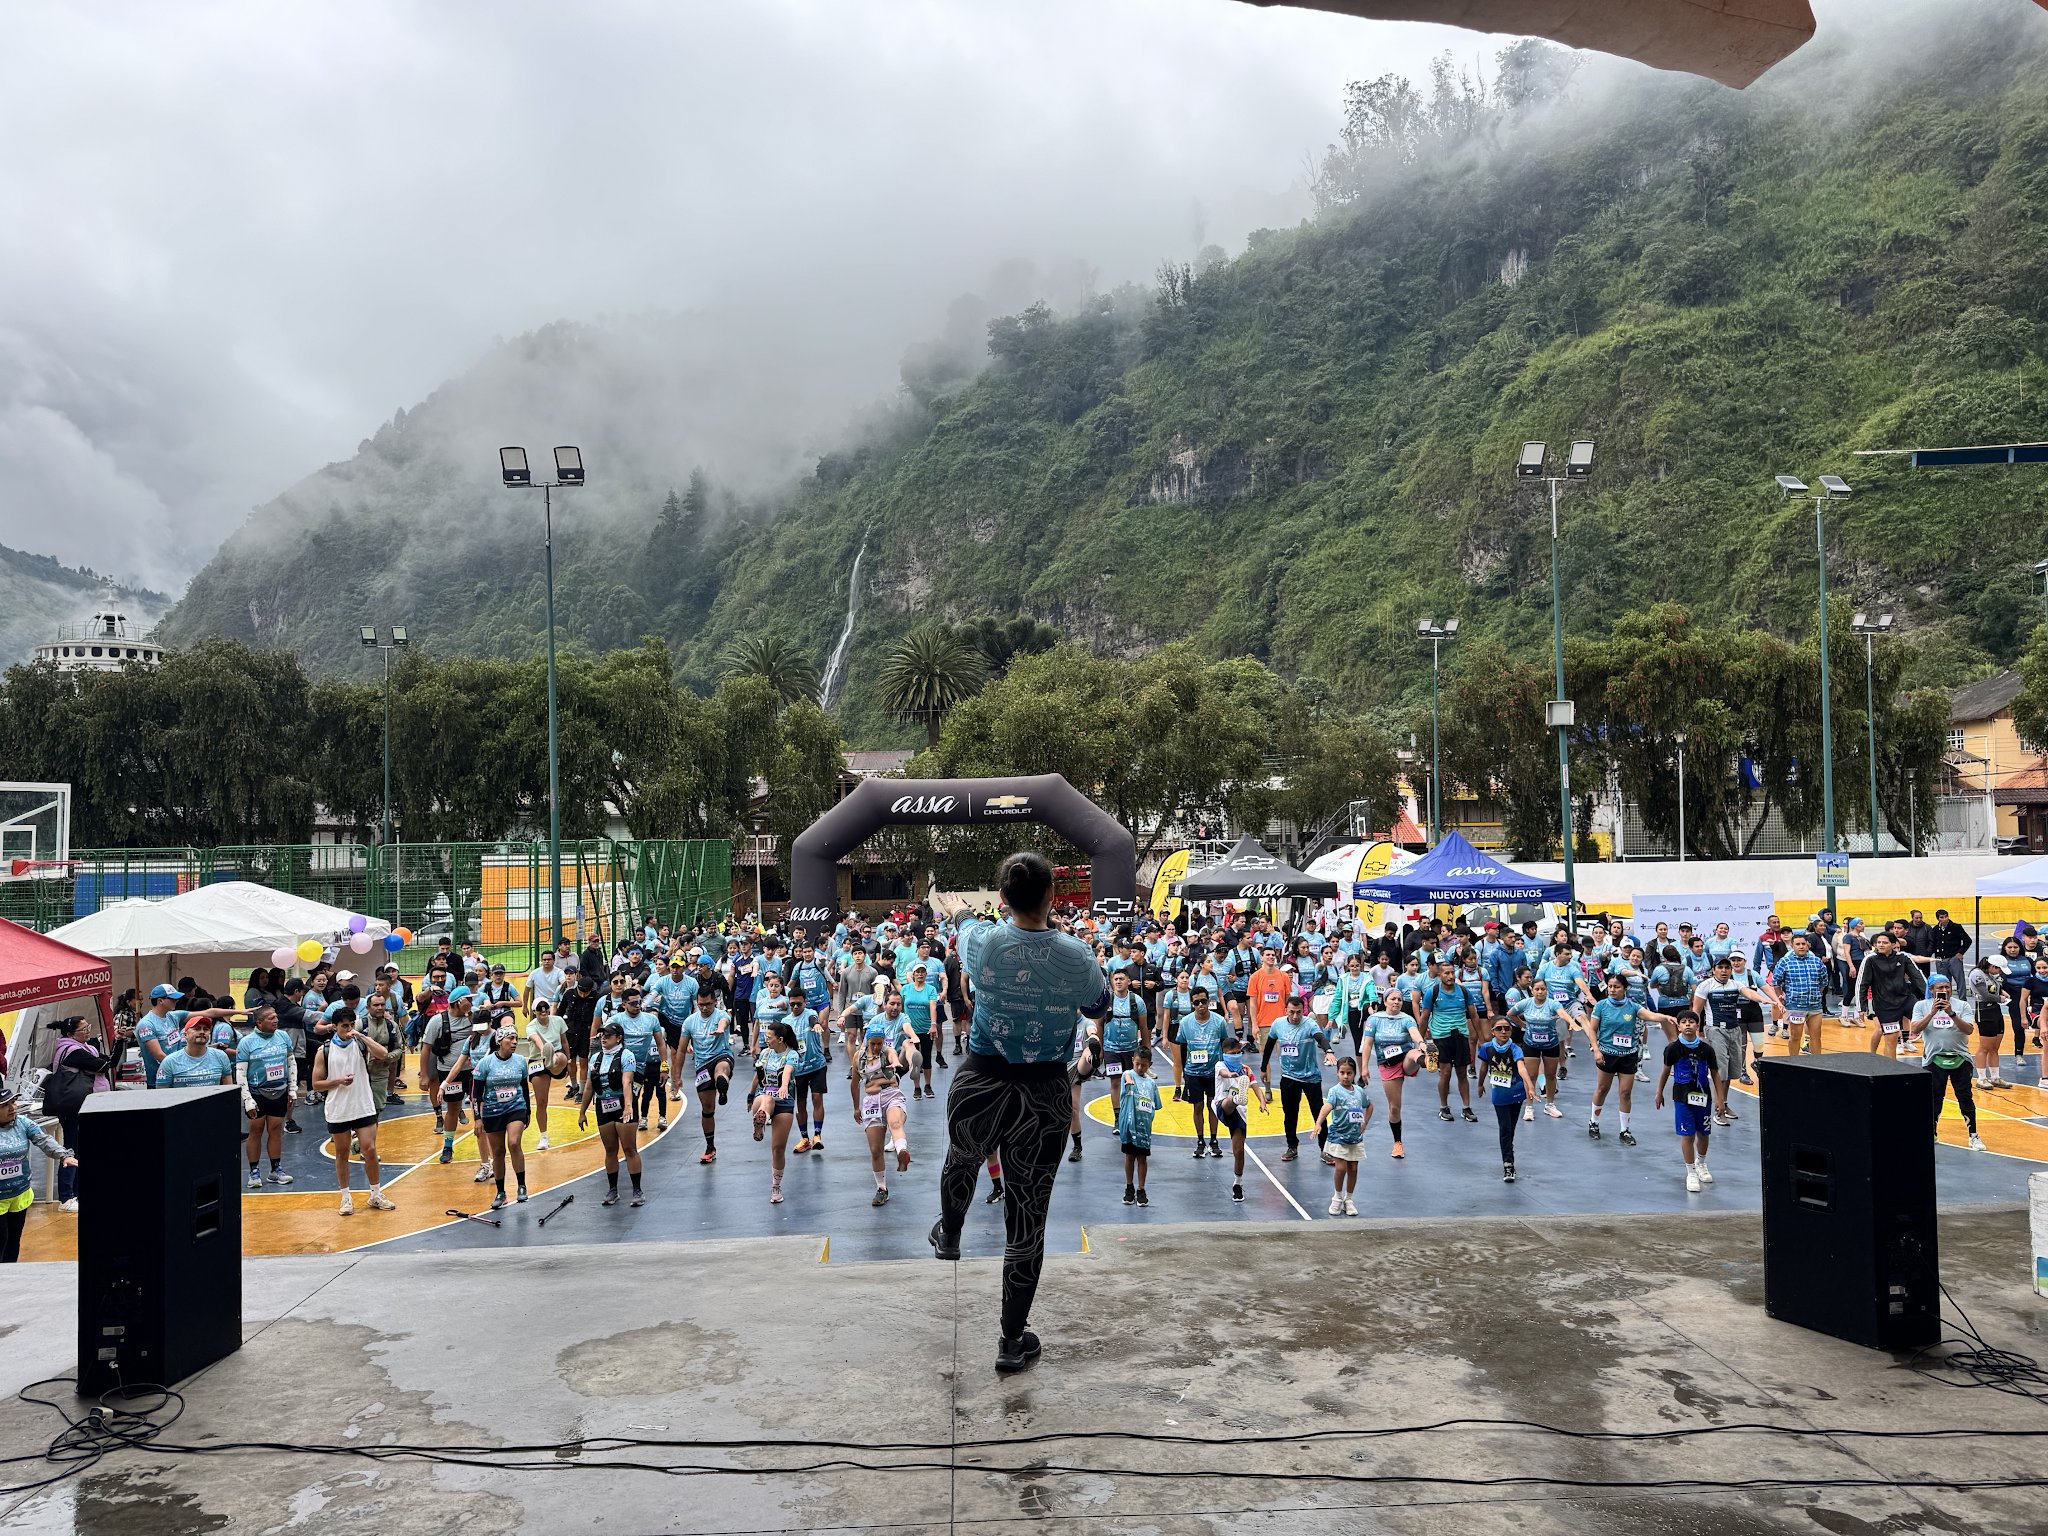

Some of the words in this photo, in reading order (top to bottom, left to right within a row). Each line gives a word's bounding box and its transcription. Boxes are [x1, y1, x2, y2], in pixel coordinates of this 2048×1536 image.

[890, 795, 960, 814] assa
[983, 808, 1033, 816] CHEVROLET
[1446, 866, 1501, 877] assa
[1239, 883, 1289, 898] assa
[1429, 891, 1470, 900] NUEVOS
[1471, 891, 1478, 899] Y
[1479, 889, 1542, 899] SEMINUEVOS
[57, 978, 70, 990] 03
[71, 970, 110, 988] 2740500
[1493, 1075, 1509, 1083] 022
[1, 1165, 19, 1175] 050
